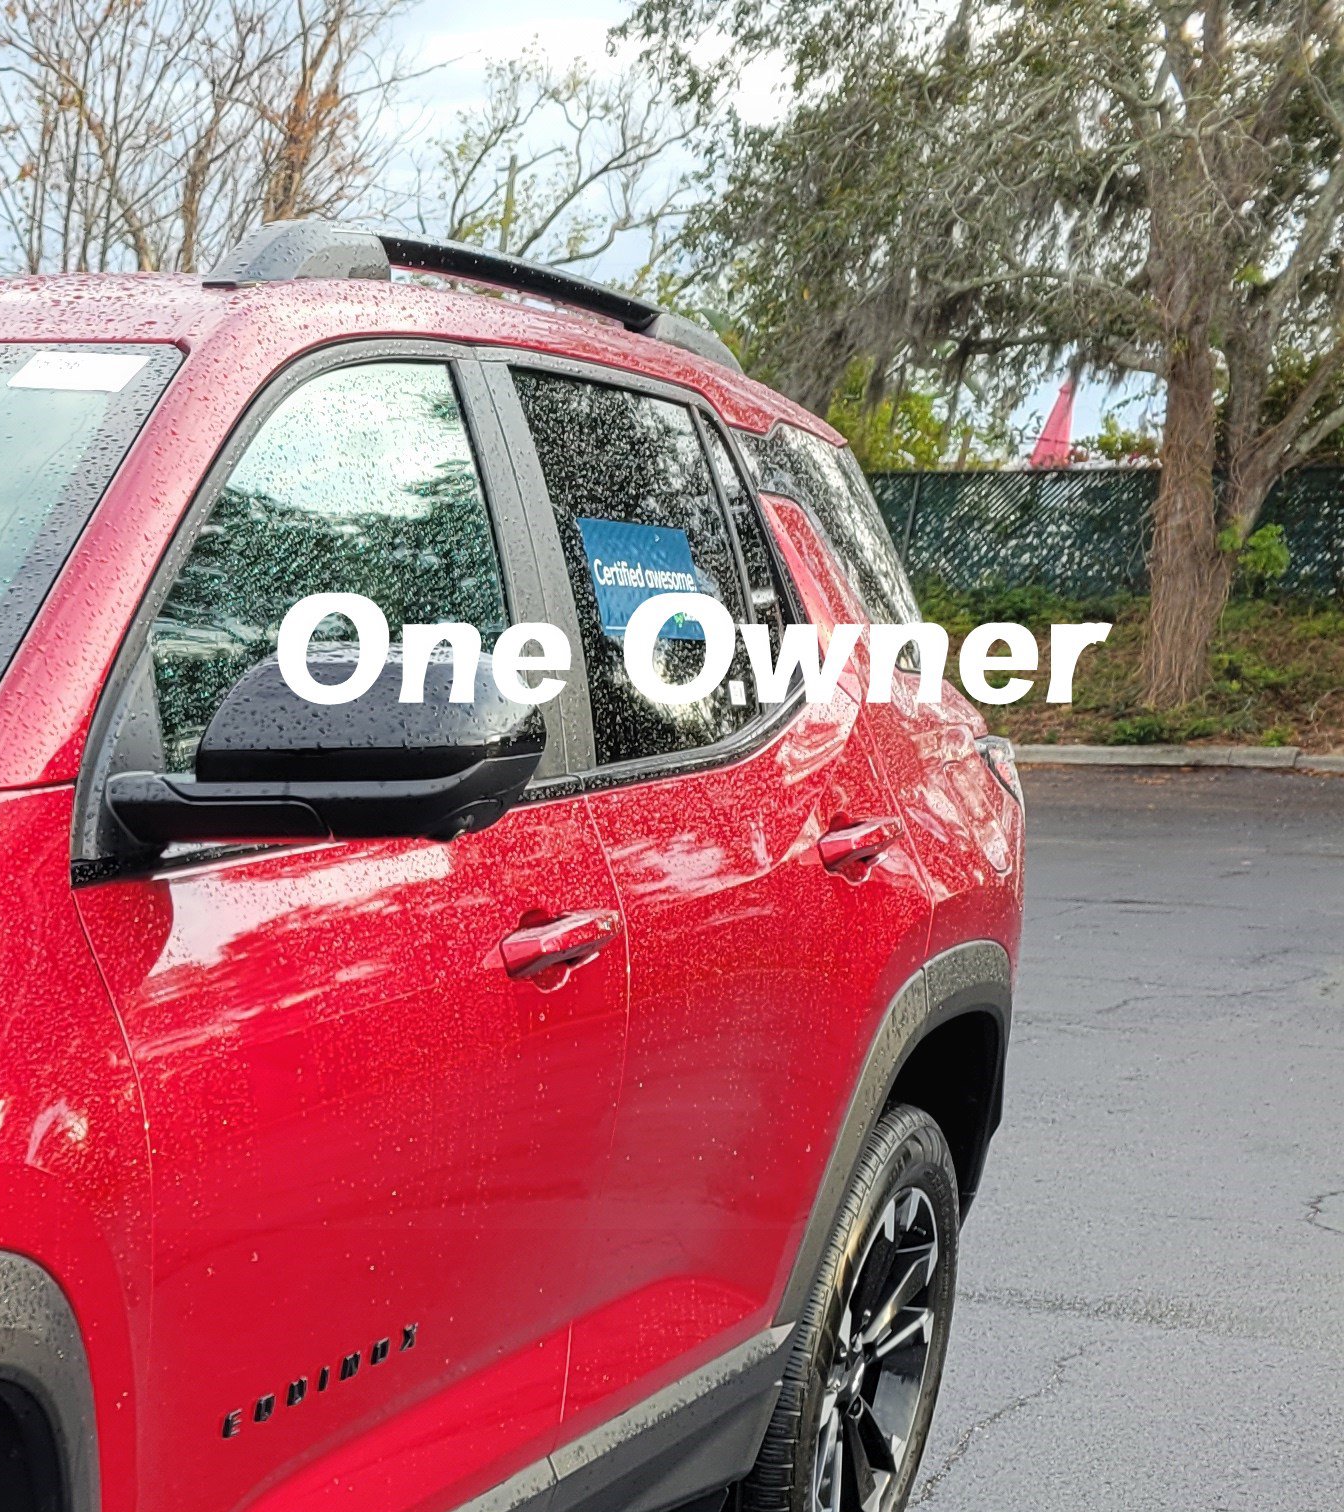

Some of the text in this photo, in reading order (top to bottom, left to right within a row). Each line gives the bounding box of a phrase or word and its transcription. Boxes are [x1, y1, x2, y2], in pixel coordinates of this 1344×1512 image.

[593, 558, 698, 592] Certified awesome.
[221, 1321, 419, 1439] EQUINOX
